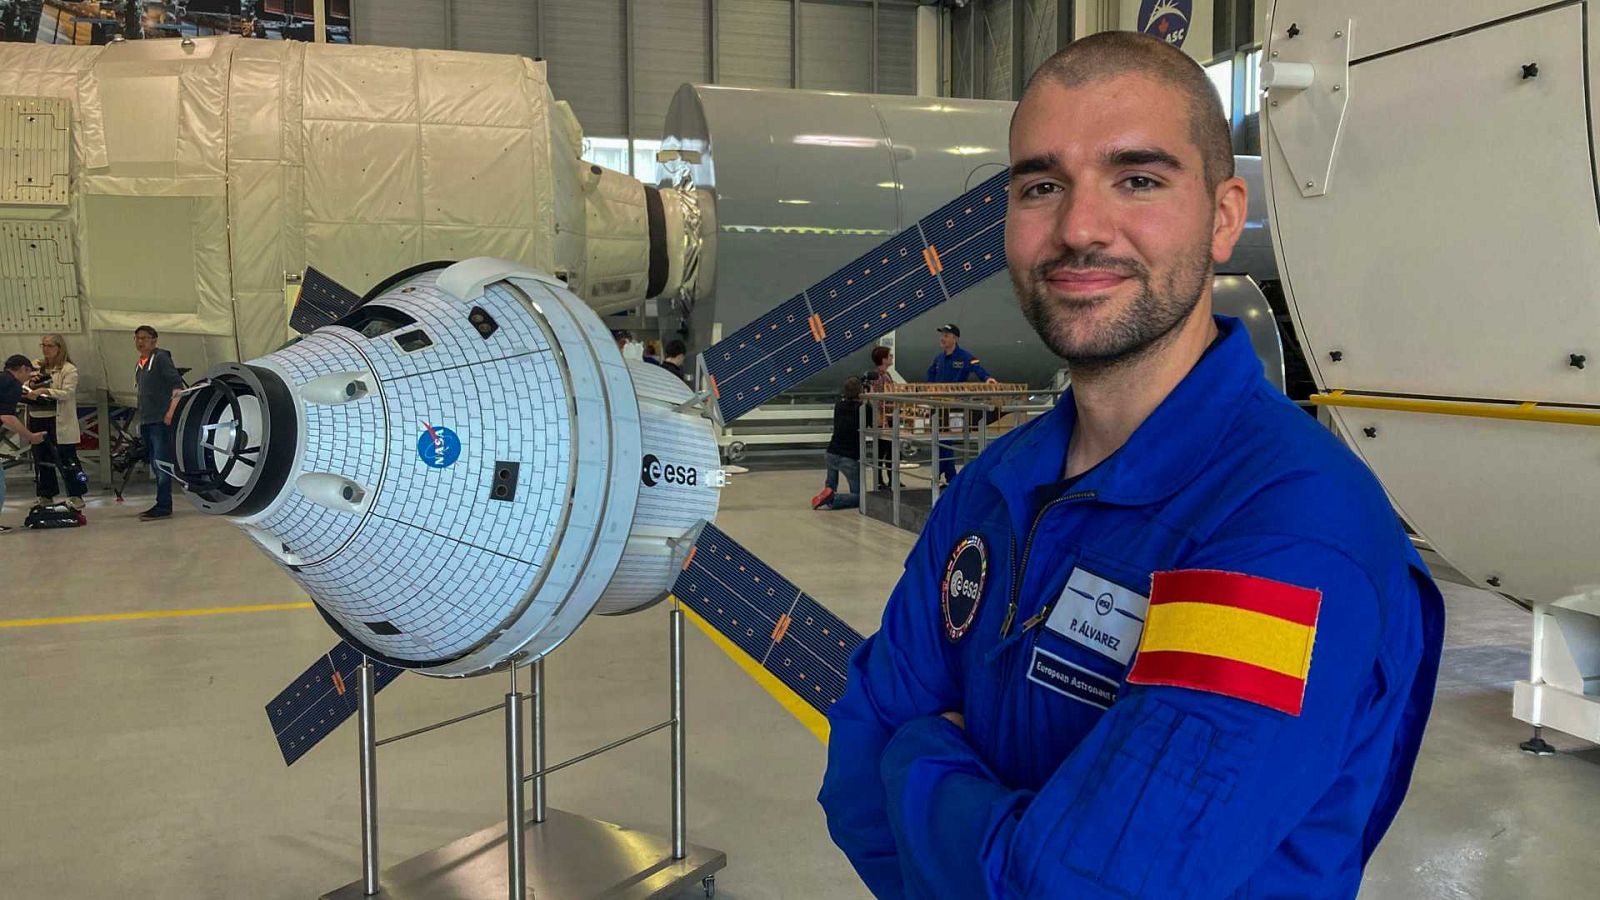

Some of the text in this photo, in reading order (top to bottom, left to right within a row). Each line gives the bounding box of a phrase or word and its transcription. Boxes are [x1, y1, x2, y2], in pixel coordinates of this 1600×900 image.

[1165, 28, 1185, 44] ASC
[434, 428, 445, 465] NASA
[664, 463, 697, 487] esa
[962, 579, 979, 600] esa
[1070, 618, 1121, 651] P. ÁLVAREZ
[1036, 661, 1111, 701] European Astronaut
